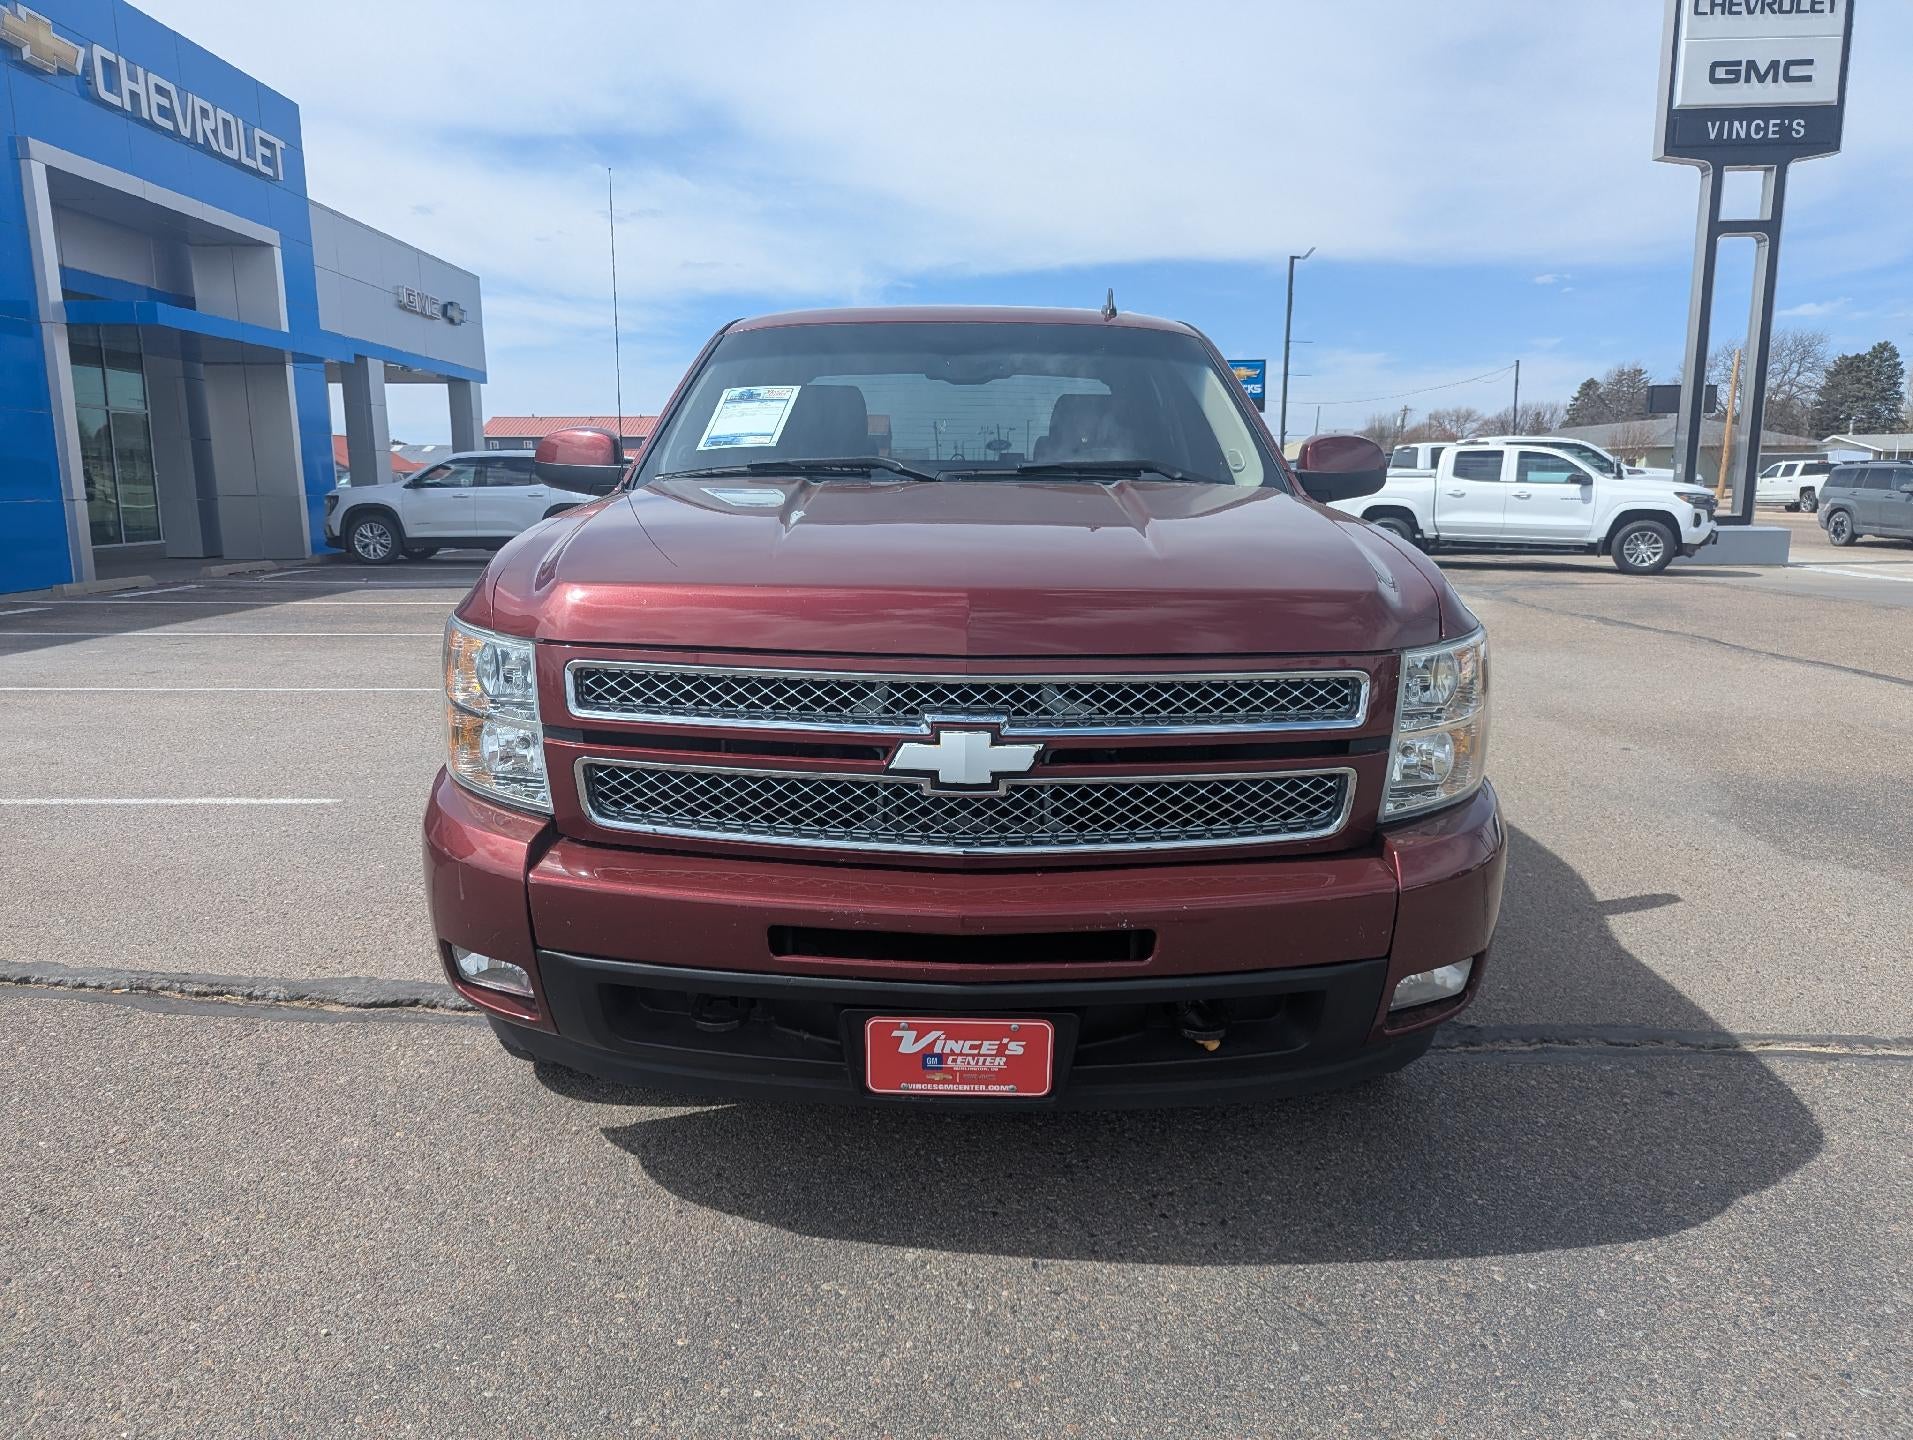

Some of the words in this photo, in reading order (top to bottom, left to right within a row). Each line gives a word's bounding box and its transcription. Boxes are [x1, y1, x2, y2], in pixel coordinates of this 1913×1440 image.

[1709, 58, 1814, 84] GMC
[91, 43, 287, 181] CHEVROLET
[1707, 119, 1805, 140] VINCE'S
[400, 285, 442, 321] GMC
[926, 1057, 938, 1065] GM
[947, 1056, 1006, 1066] CENTER
